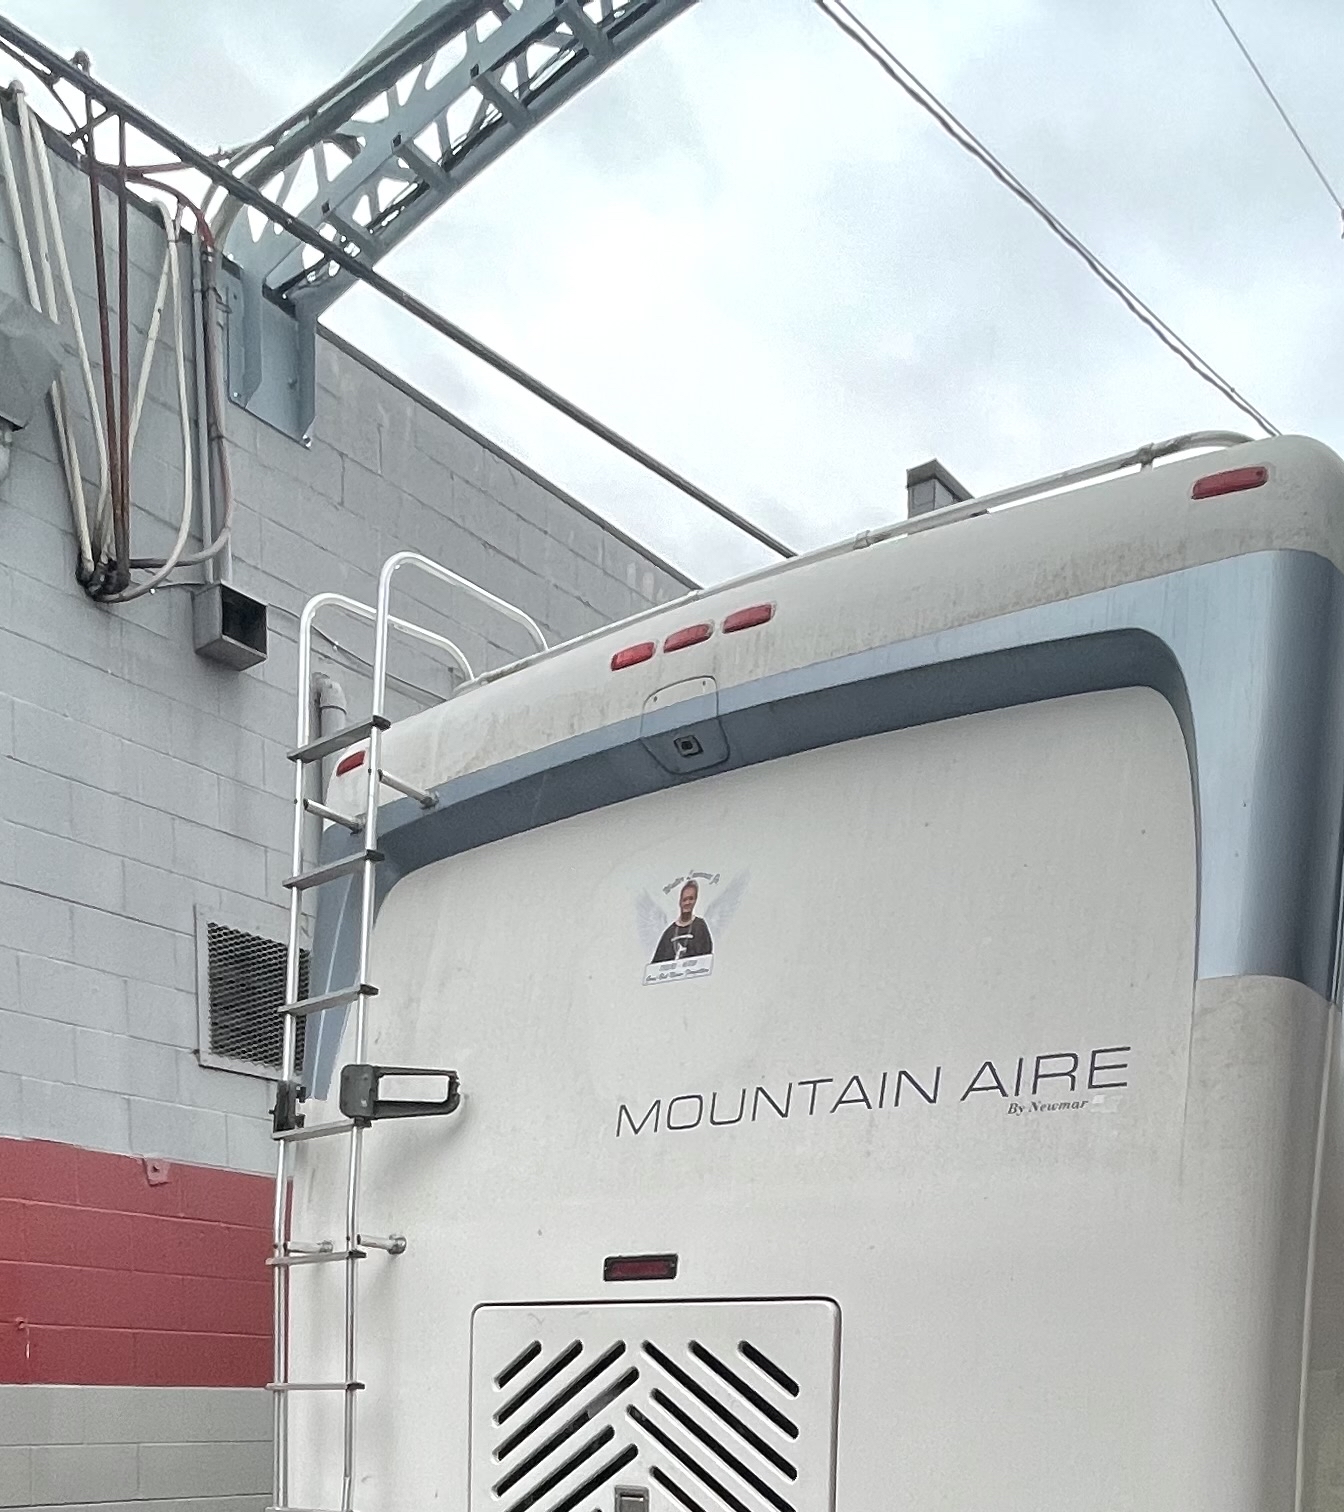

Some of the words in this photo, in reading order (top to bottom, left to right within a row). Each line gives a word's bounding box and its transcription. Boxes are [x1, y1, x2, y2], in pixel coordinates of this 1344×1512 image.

[614, 1065, 942, 1138] MOUNTAIN
[959, 1045, 1132, 1103] AIRE
[1007, 1102, 1024, 1116] By
[1028, 1100, 1089, 1113] Newmar
